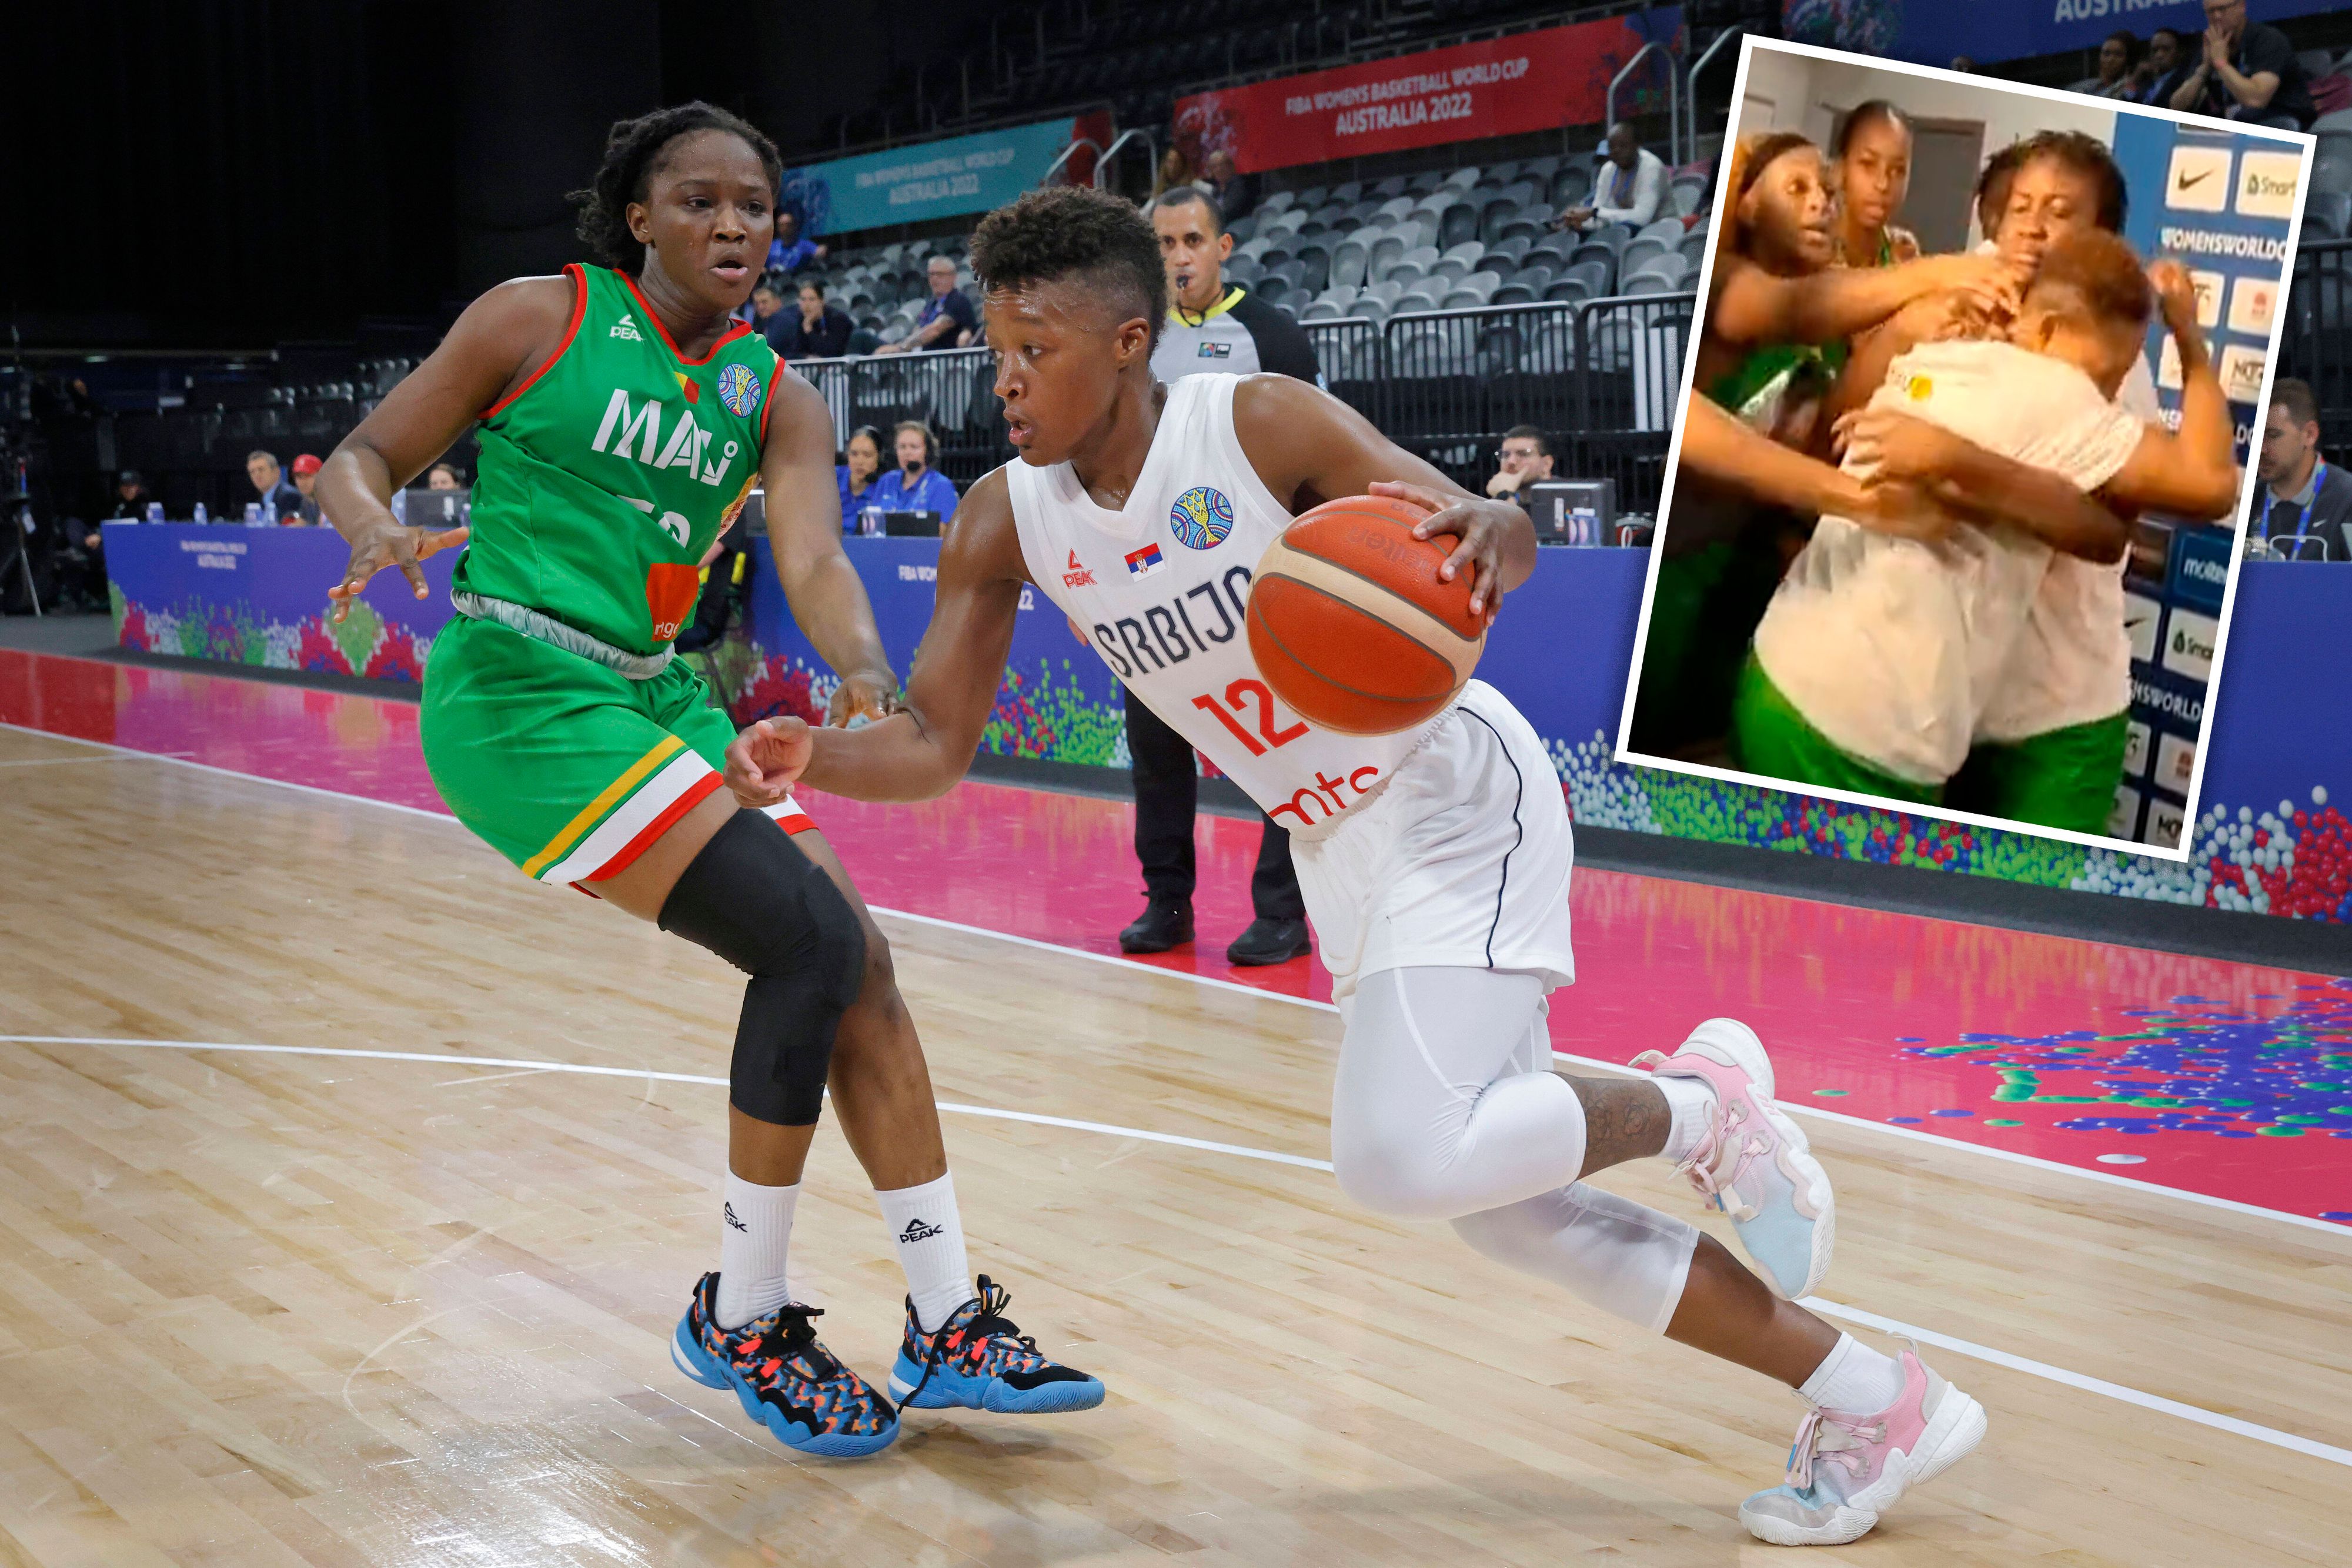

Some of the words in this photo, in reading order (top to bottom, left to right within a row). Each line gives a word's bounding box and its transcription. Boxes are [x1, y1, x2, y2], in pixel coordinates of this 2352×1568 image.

[1371, 72, 1451, 102] BASKETBALL
[1451, 62, 1501, 87] WORLD
[1502, 56, 1529, 80] CUP
[1336, 100, 1428, 136] AUSTRALIA
[1430, 91, 1473, 122] 2022
[609, 325, 646, 342] PEA
[1062, 569, 1098, 589] PEAK
[1191, 678, 1310, 757] 12
[900, 1224, 943, 1243] PEAK
